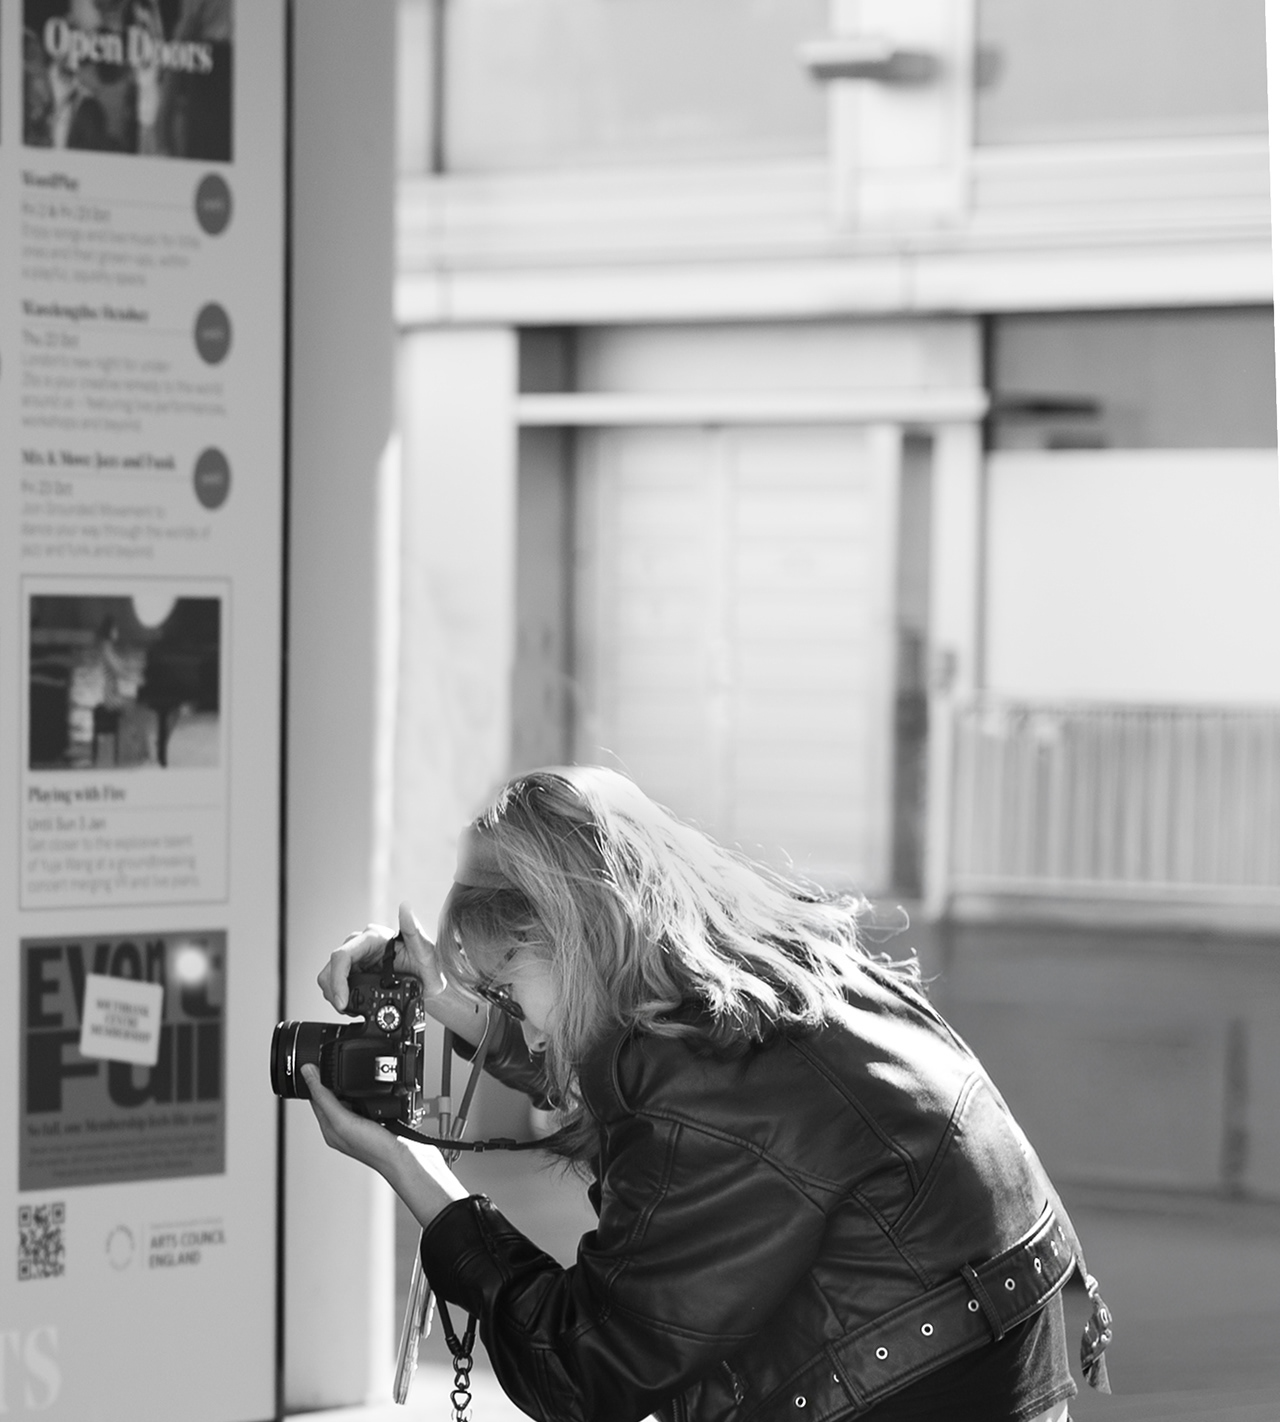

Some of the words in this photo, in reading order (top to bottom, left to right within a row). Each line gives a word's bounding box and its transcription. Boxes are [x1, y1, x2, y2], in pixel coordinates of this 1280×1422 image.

[44, 17, 124, 71] Open
[127, 25, 214, 74] Doors
[150, 1234, 177, 1249] ARTS
[180, 1230, 225, 1246] COUNCIL
[149, 1251, 201, 1268] ENGLAND
